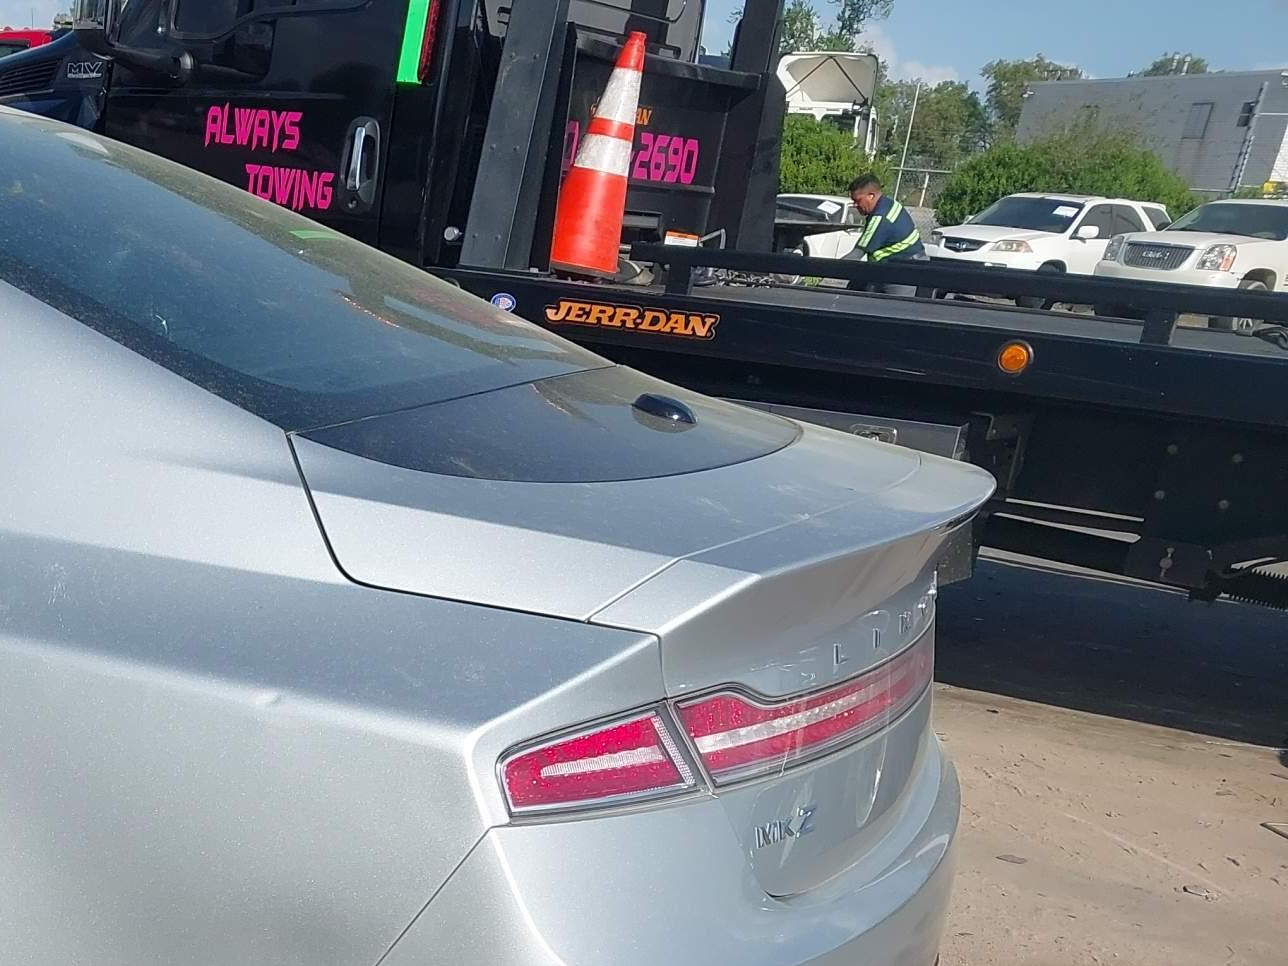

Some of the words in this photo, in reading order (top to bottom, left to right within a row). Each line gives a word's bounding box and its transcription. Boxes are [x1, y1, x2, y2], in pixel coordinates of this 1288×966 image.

[67, 61, 103, 75] MV
[204, 101, 304, 152] ALWAYS
[245, 164, 335, 211] TOWING
[545, 301, 718, 338] JERR-DAN
[754, 806, 816, 849] MKZ
